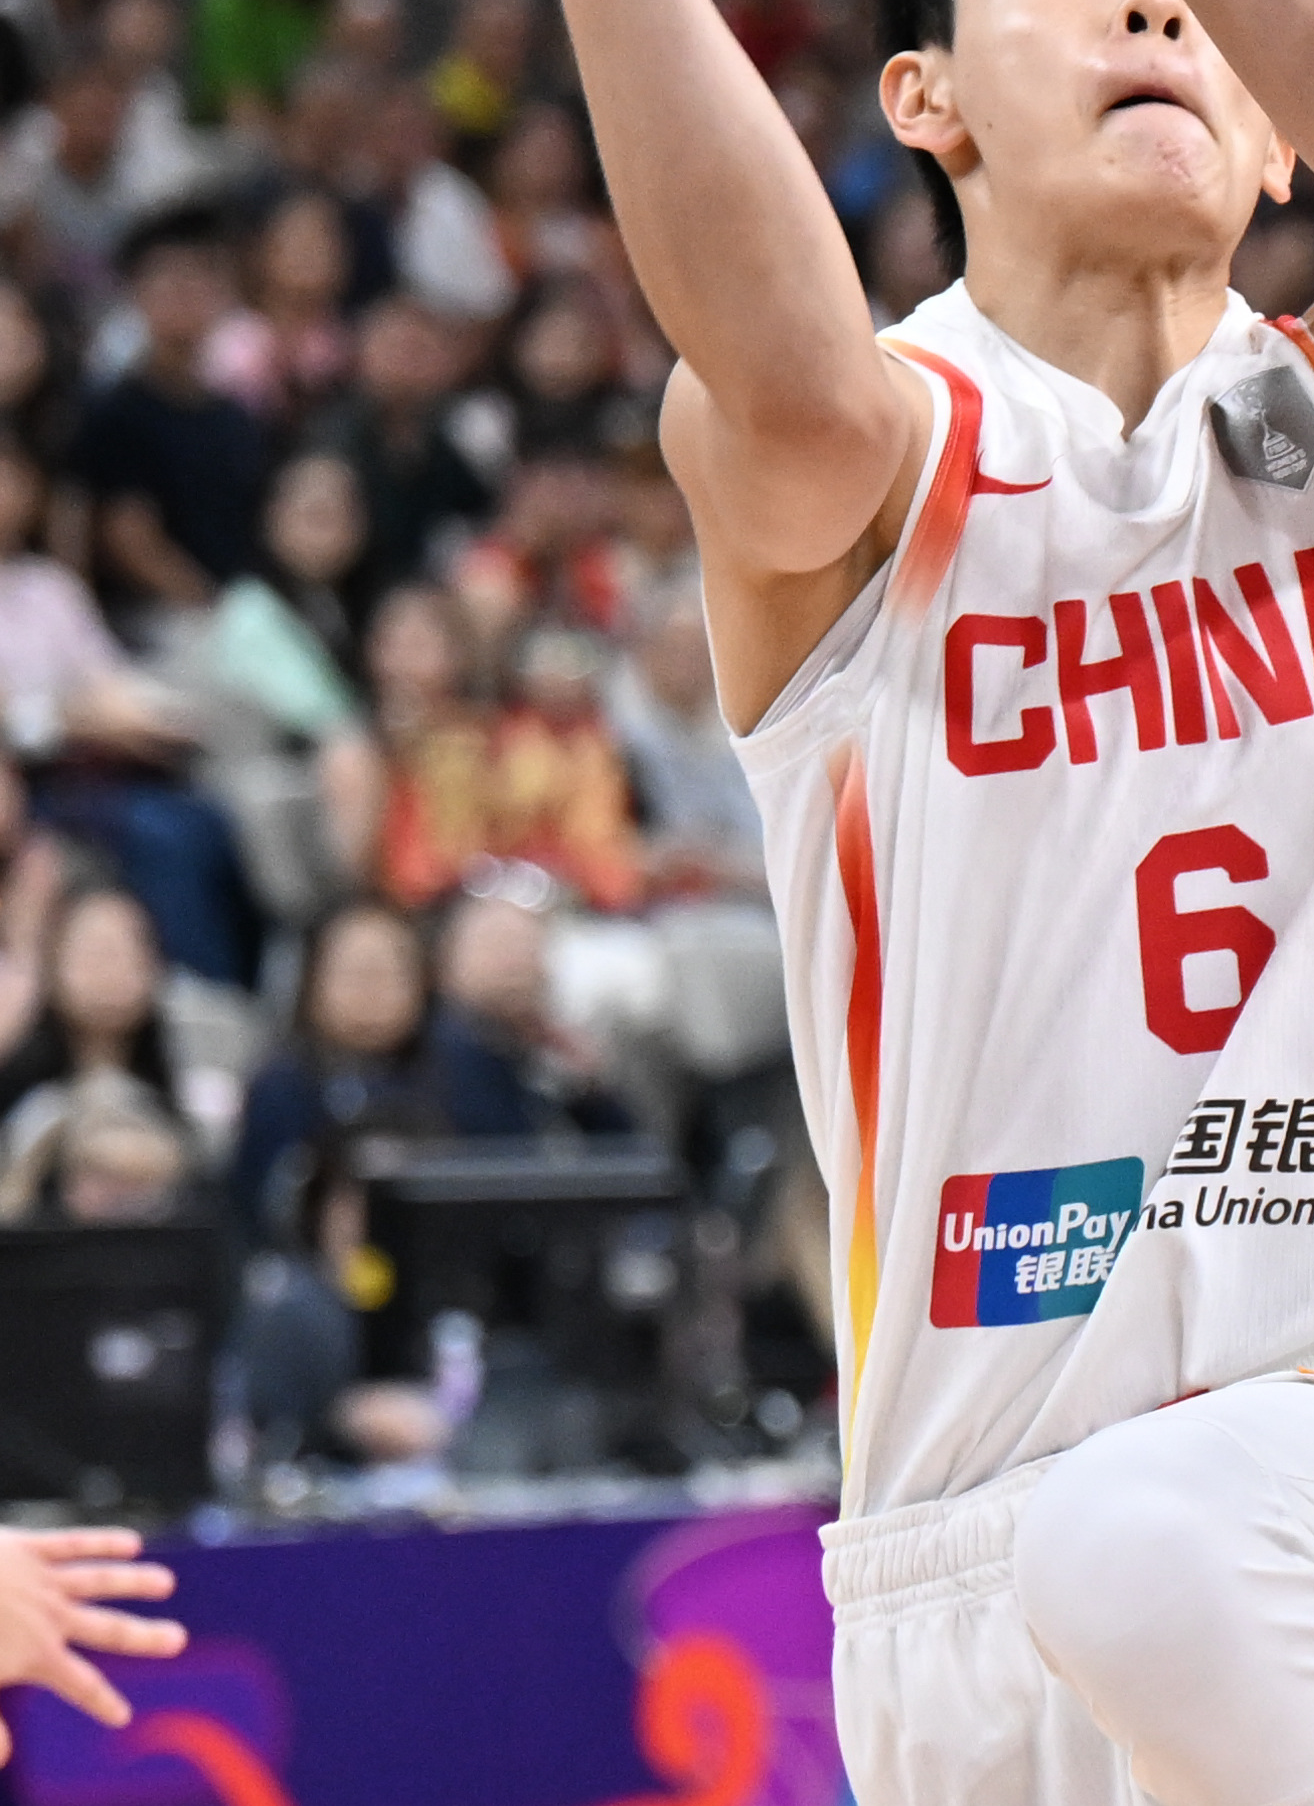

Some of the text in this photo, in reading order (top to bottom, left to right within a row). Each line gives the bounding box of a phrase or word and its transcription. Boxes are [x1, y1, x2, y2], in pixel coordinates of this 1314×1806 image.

[1135, 824, 1277, 1056] 6
[943, 1201, 1131, 1253] UnionPay
[1013, 1245, 1116, 1295] 银联
